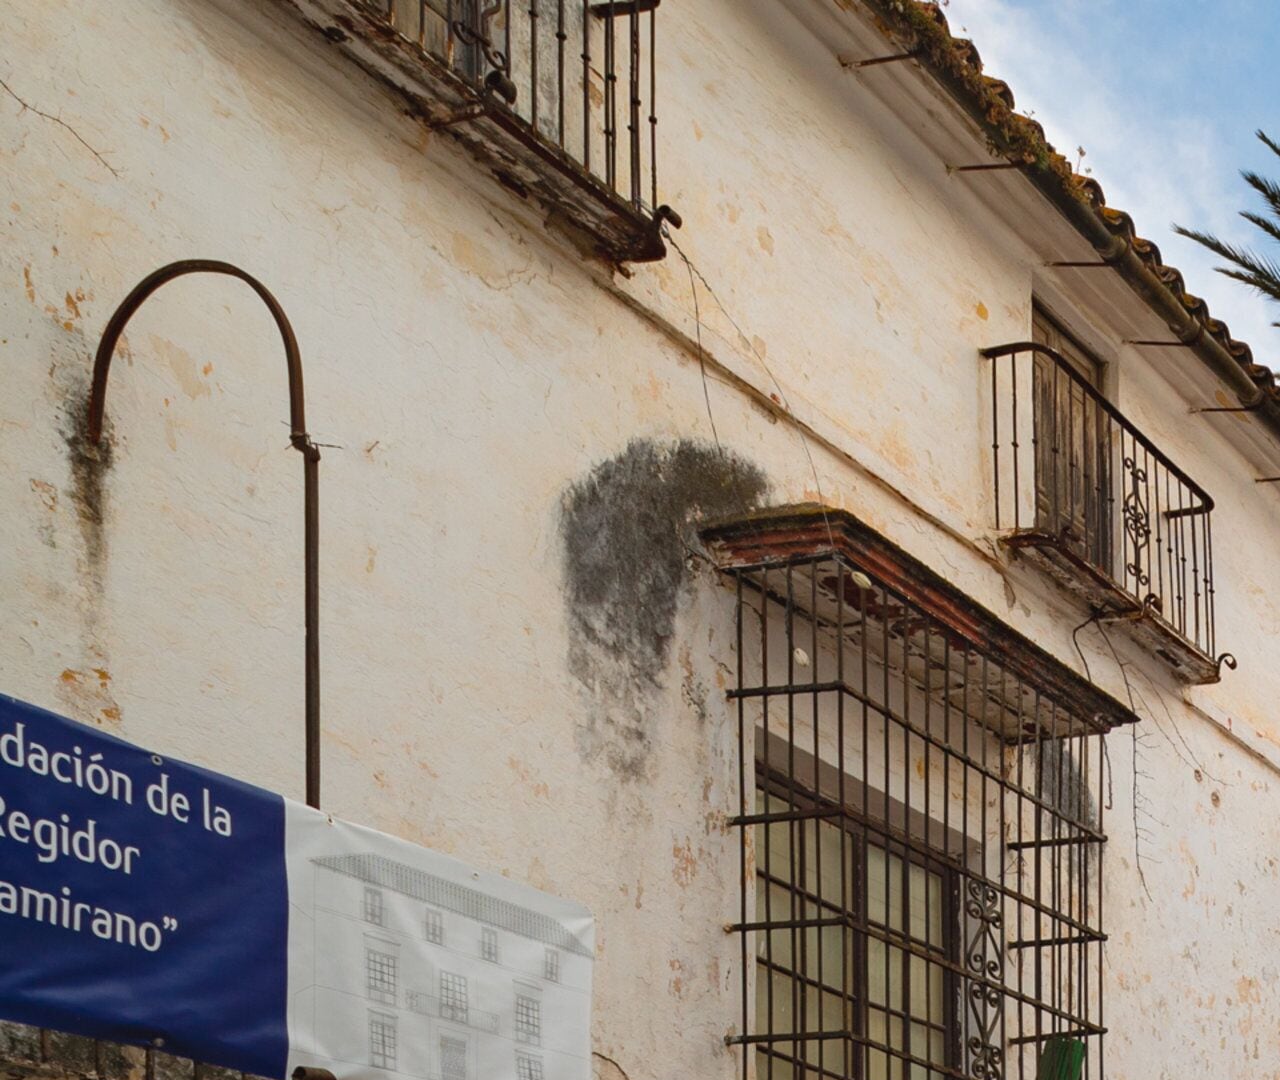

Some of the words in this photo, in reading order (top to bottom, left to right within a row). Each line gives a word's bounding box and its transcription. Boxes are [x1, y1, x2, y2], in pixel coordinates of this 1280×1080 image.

[0, 722, 133, 805] dación
[146, 772, 190, 824] de
[202, 788, 233, 837] la
